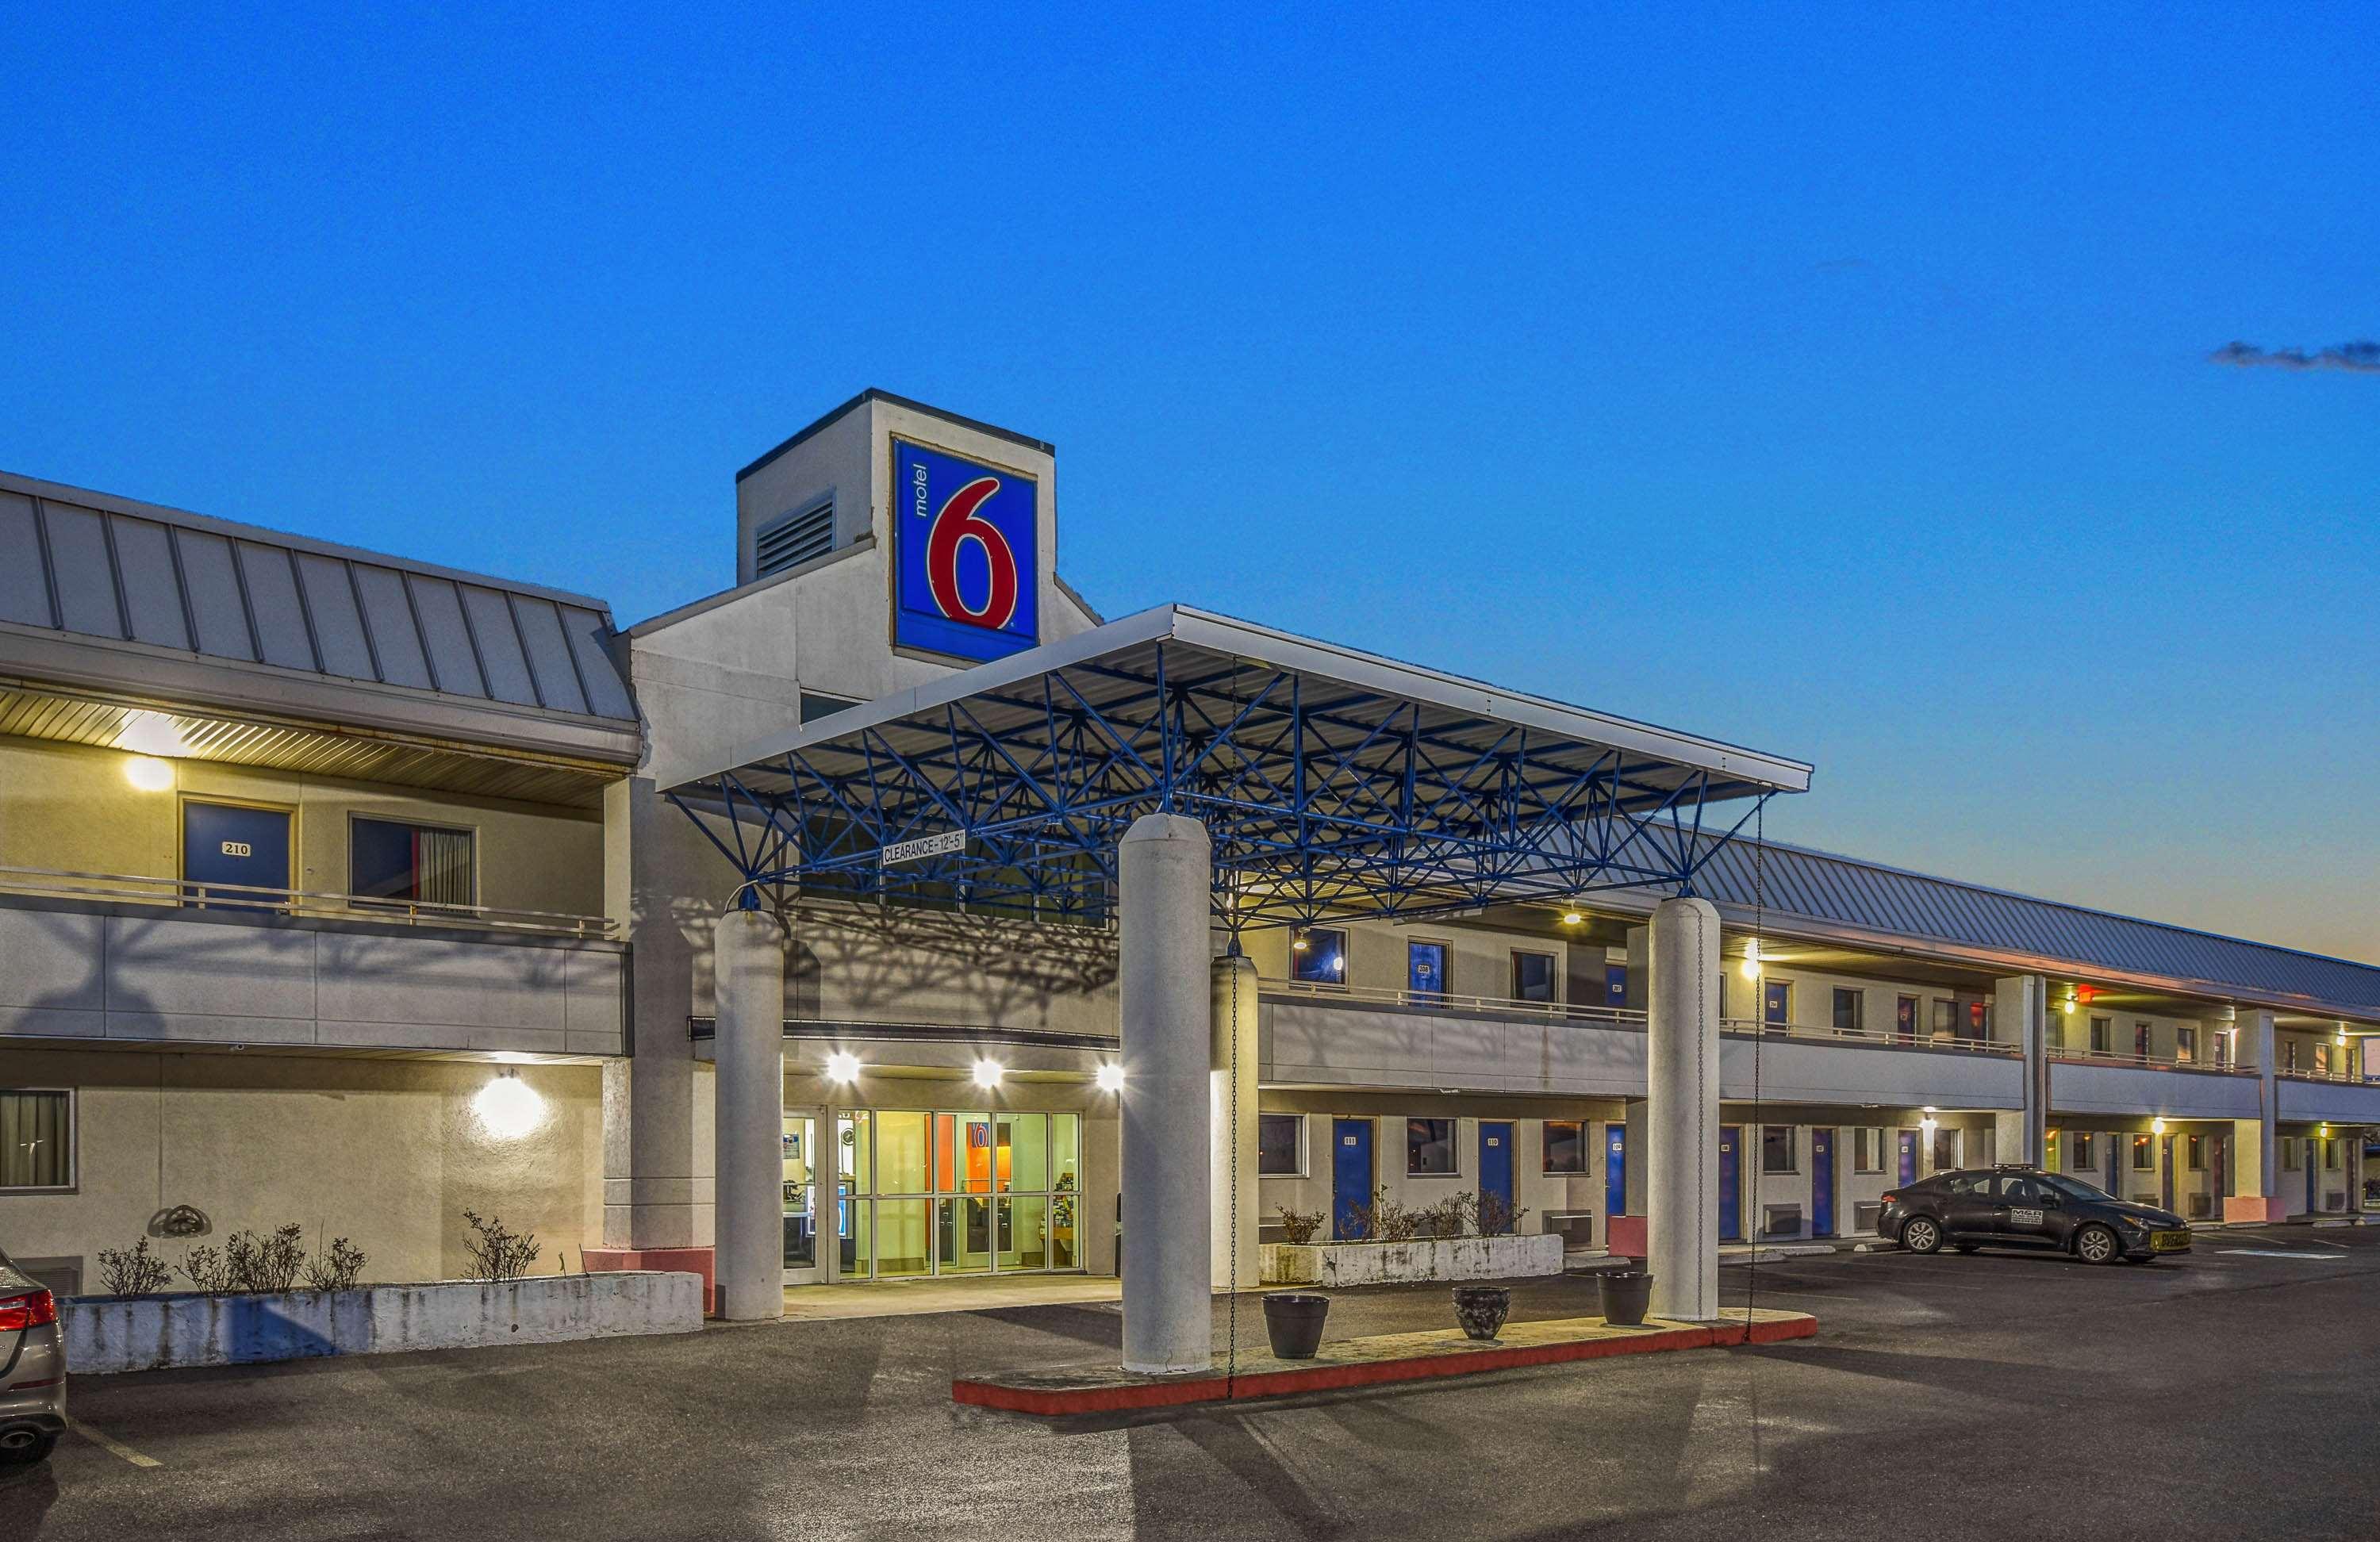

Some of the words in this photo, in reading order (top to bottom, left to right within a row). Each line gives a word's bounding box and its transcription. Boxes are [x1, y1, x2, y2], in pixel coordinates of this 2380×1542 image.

[913, 463, 927, 516] motel
[927, 477, 1017, 629] 6
[225, 844, 248, 854] 210
